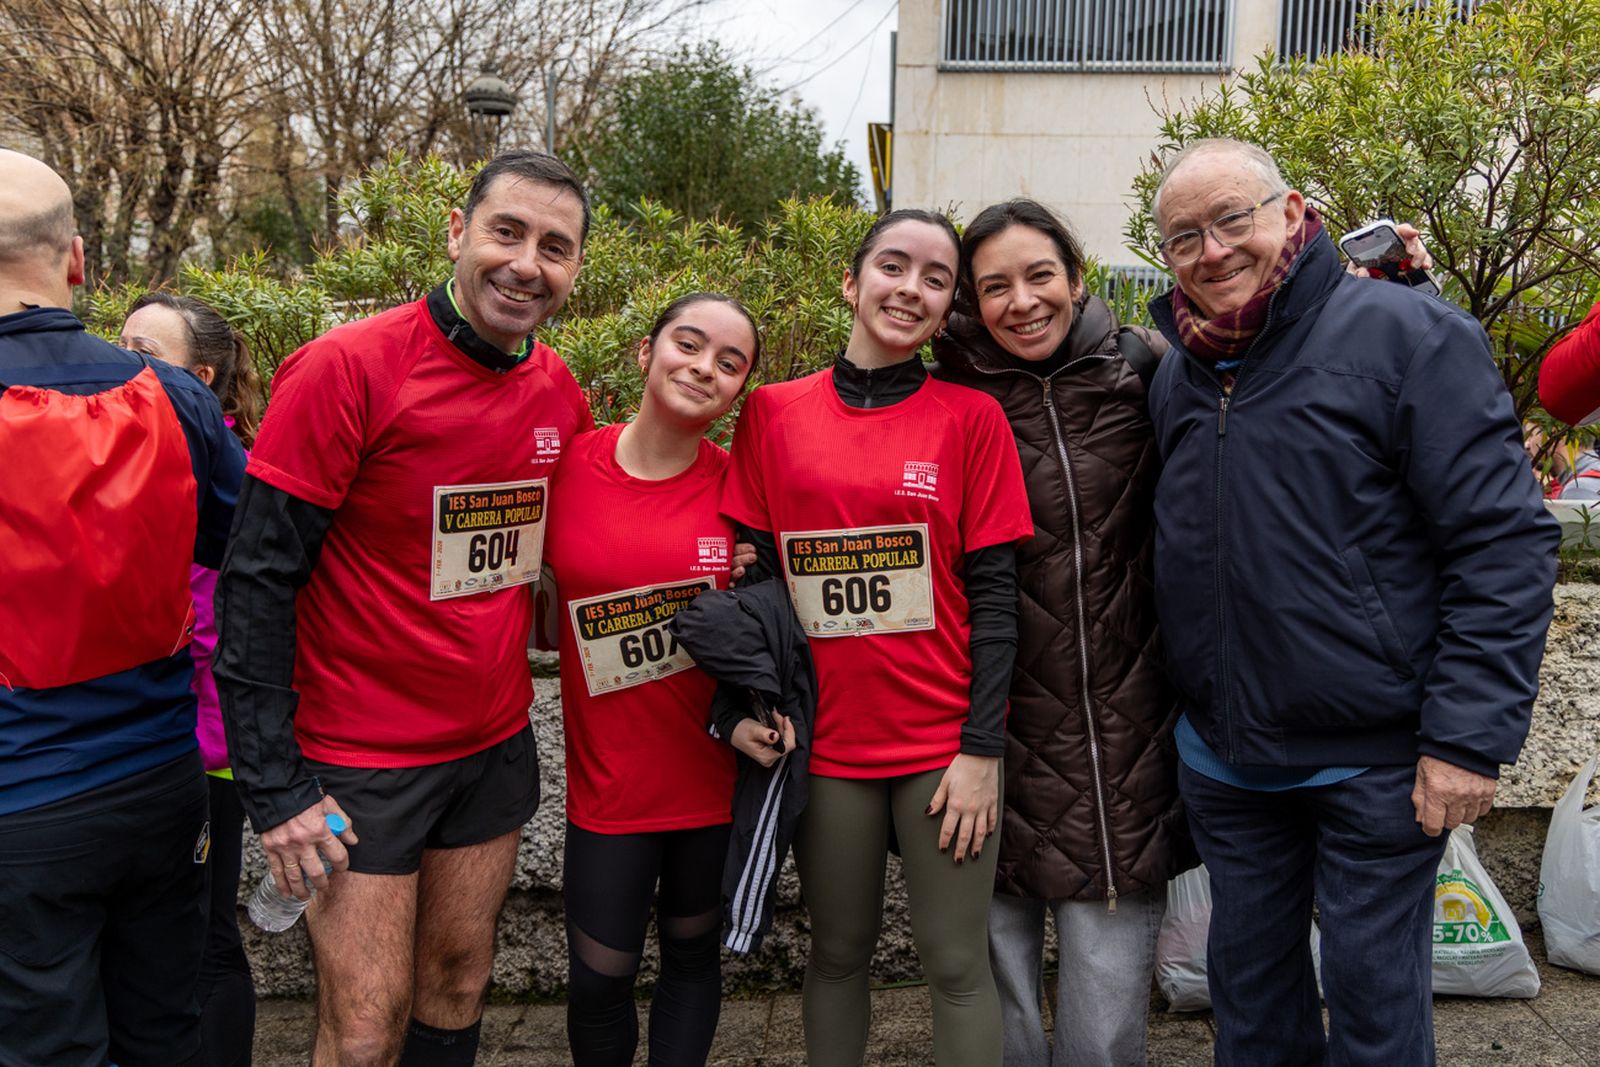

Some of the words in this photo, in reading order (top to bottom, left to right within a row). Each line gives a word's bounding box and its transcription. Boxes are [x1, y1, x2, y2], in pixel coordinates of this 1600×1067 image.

[449, 495, 466, 511] IES
[469, 495, 489, 509] San
[491, 493, 514, 507] Juan
[516, 490, 540, 504] Bosco
[445, 514, 454, 529] V
[456, 510, 502, 529] CARRERA
[504, 505, 541, 524] POPULAR
[468, 529, 520, 573] 604
[794, 541, 812, 555] IES
[815, 540, 839, 554] San
[842, 538, 872, 552] Juan
[875, 535, 913, 549] Bosco
[792, 557, 800, 572] V
[803, 554, 859, 572] CARRERA
[862, 550, 919, 569] POPULAR
[585, 604, 605, 620] IES
[607, 601, 632, 615] San
[635, 592, 662, 610] Juan
[665, 587, 701, 600] Bosco
[822, 574, 892, 617] 606
[584, 623, 594, 637] V
[598, 610, 653, 634] CARRERA
[620, 623, 679, 669] 607
